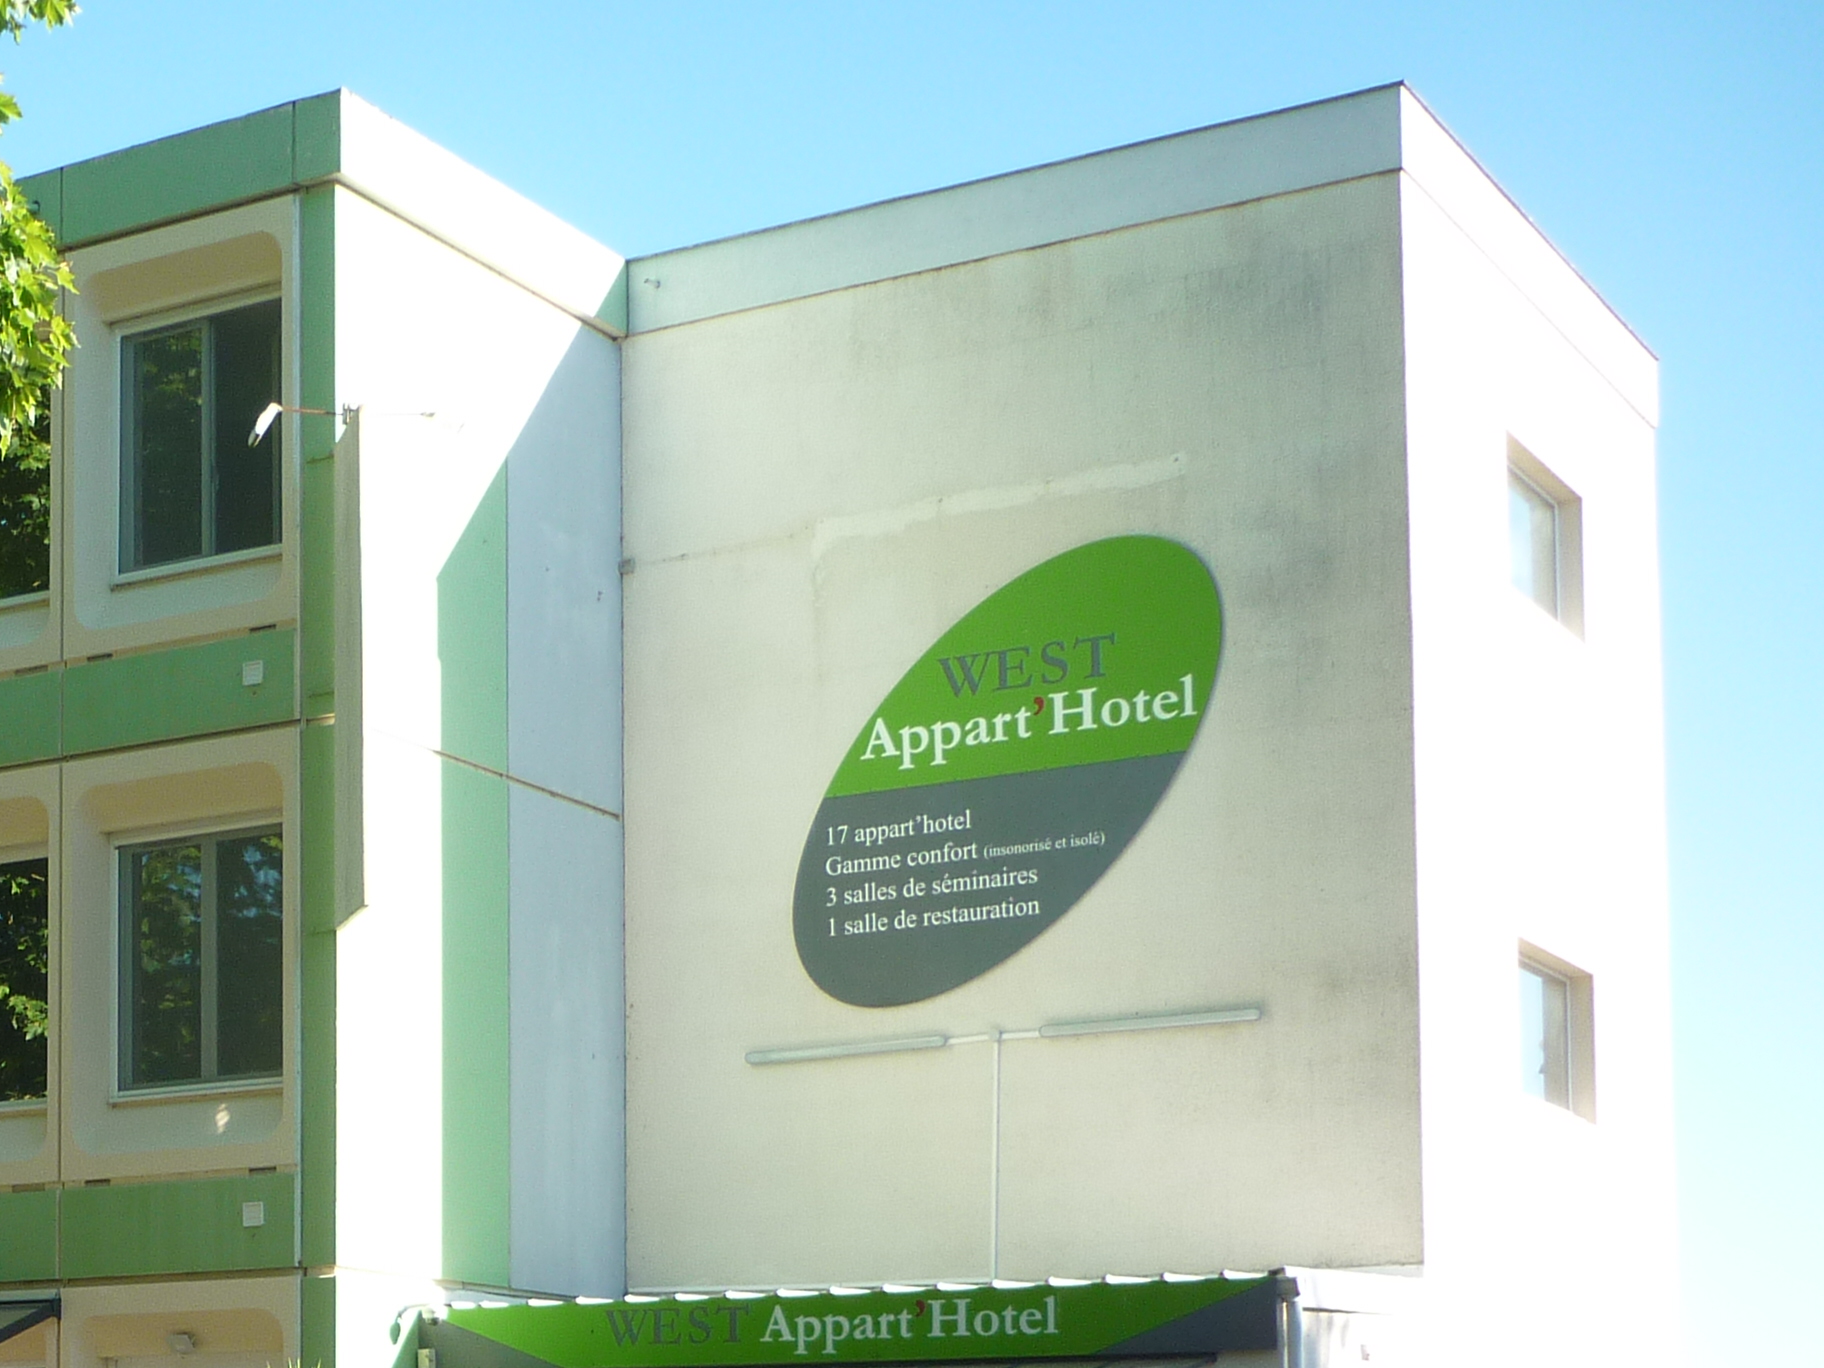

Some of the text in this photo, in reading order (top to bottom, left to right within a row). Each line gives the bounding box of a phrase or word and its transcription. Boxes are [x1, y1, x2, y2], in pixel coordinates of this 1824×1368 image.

[939, 632, 1115, 699] WEST
[860, 674, 1198, 771] Appart'Hotel
[826, 809, 972, 846] 17 appart'hotel
[826, 831, 1106, 876] Gamme confort (insonorisé et isolé)
[826, 866, 1039, 907] 3 salles de séminaires
[828, 896, 1040, 936] 1 salle de restauration
[606, 1295, 1059, 1356] WEST Appart'Hotel
